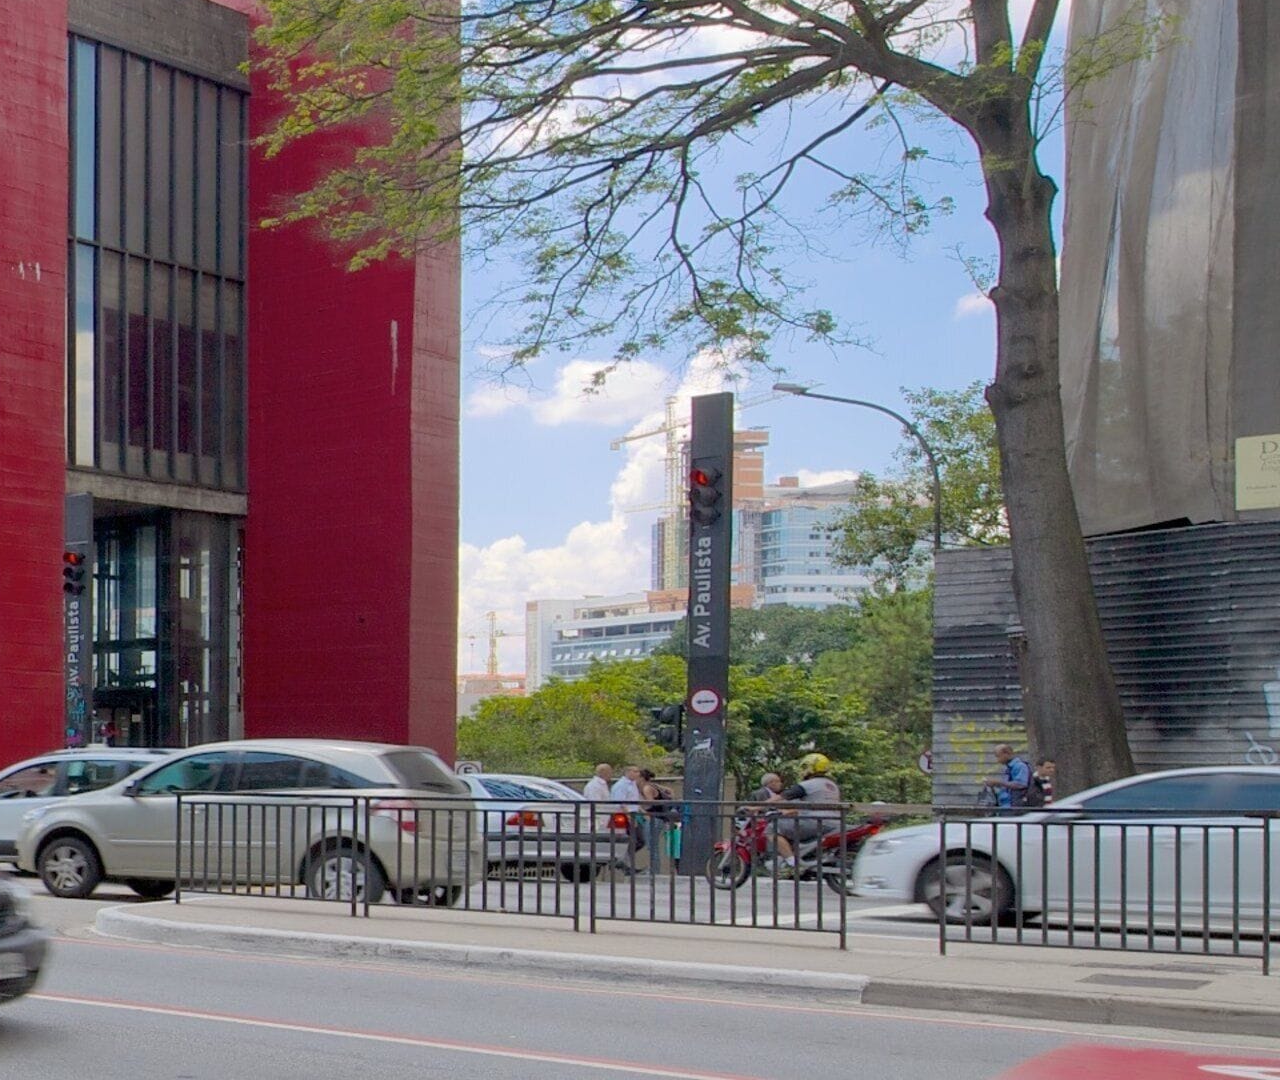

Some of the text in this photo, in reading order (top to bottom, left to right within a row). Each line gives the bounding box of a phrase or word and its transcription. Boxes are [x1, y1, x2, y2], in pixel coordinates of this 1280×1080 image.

[693, 536, 712, 616] Paulista
[68, 601, 80, 663] Paulista
[692, 621, 711, 649] Av.
[68, 666, 80, 687] Av.
